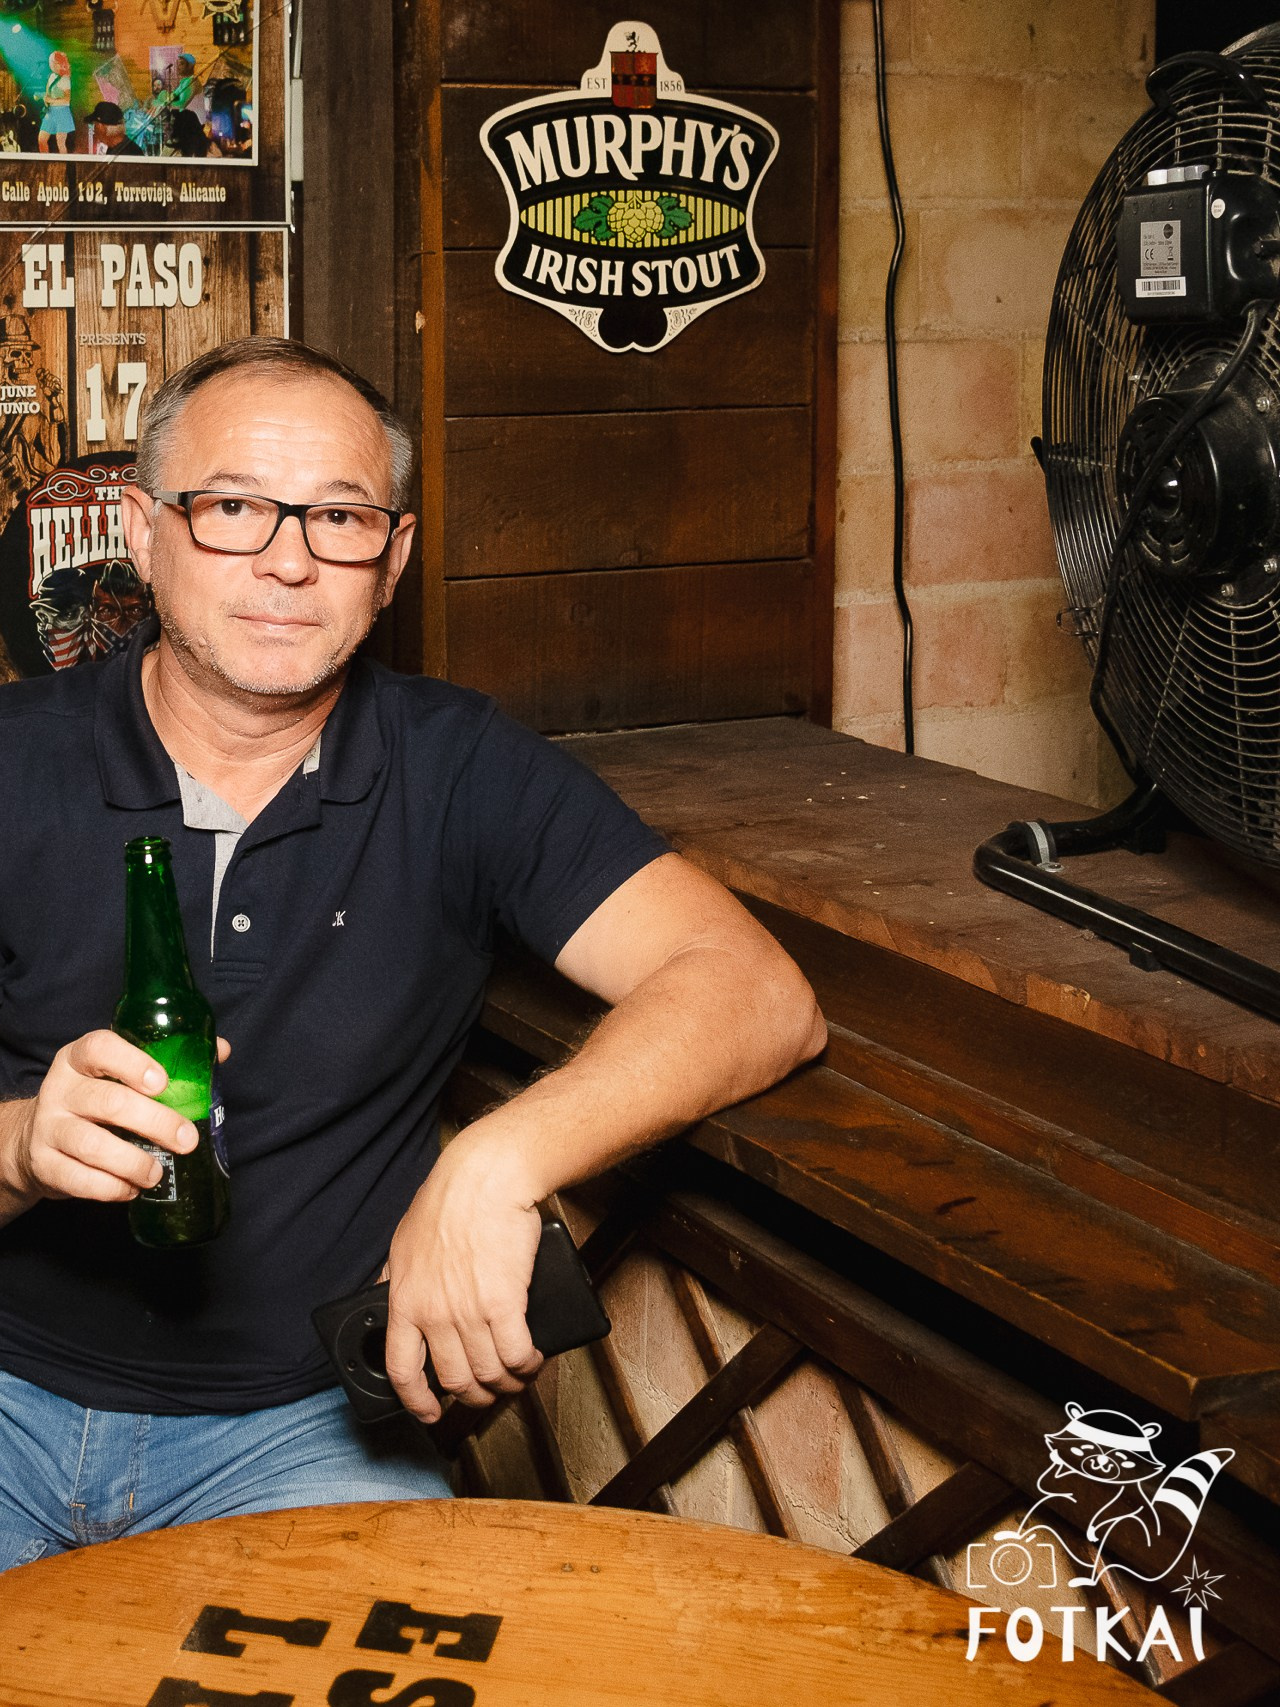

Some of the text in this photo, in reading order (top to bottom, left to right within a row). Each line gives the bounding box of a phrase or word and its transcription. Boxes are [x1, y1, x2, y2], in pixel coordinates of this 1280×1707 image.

[586, 77, 608, 90] EST
[659, 80, 683, 92] 1856
[505, 113, 756, 192] MURPHY'S
[2, 181, 227, 207] Calle Apolo 102, Torrevieja Alicante
[21, 242, 203, 308] EL PASO
[522, 243, 741, 297] IRISH STOUT
[79, 333, 147, 346] PRESENTS
[0, 385, 36, 400] JUNE
[86, 362, 147, 441] 17
